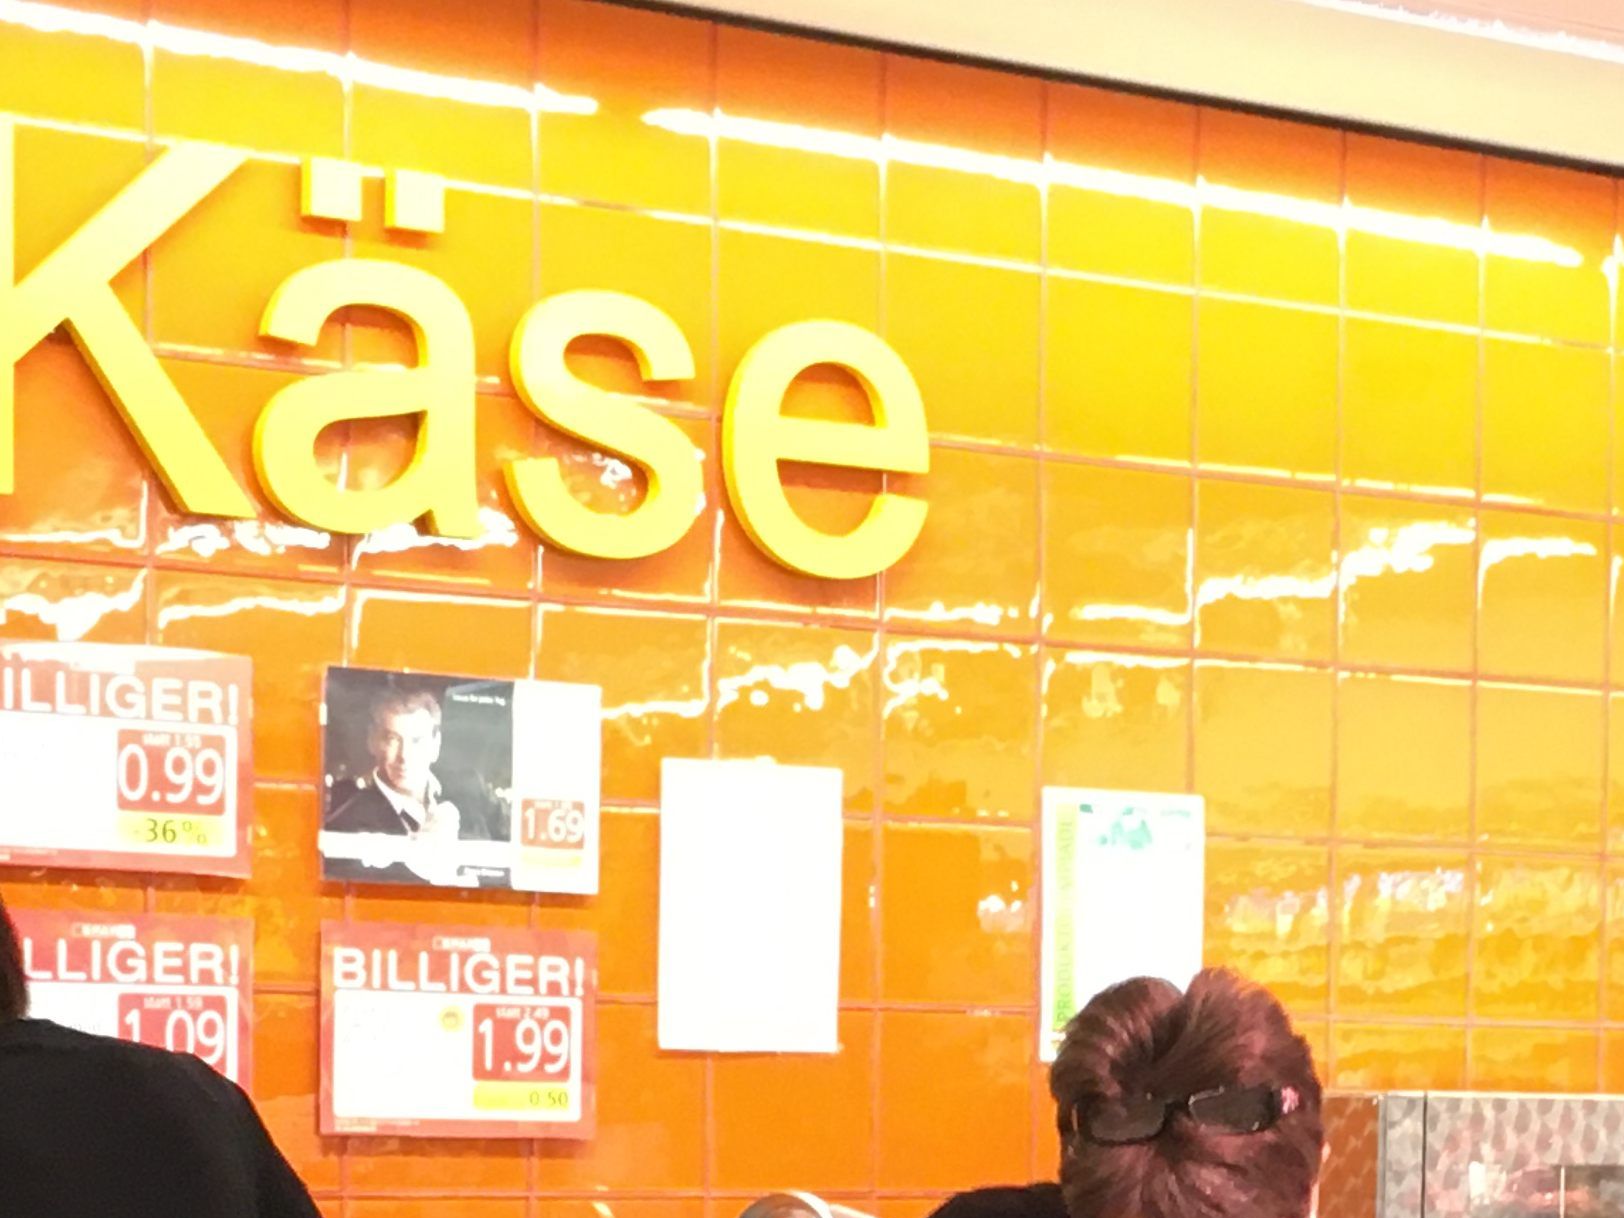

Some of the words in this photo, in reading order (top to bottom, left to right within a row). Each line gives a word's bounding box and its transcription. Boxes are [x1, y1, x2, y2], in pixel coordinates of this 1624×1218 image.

[0, 112, 931, 579] Käse
[0, 667, 239, 726] ILLIGER!
[118, 743, 225, 805] 0.99
[525, 808, 585, 843] 1.69
[23, 937, 240, 985] LLIGER!
[333, 946, 585, 997] BILLIGER!
[124, 1009, 224, 1064] 109
[478, 1018, 569, 1073] 1.99
